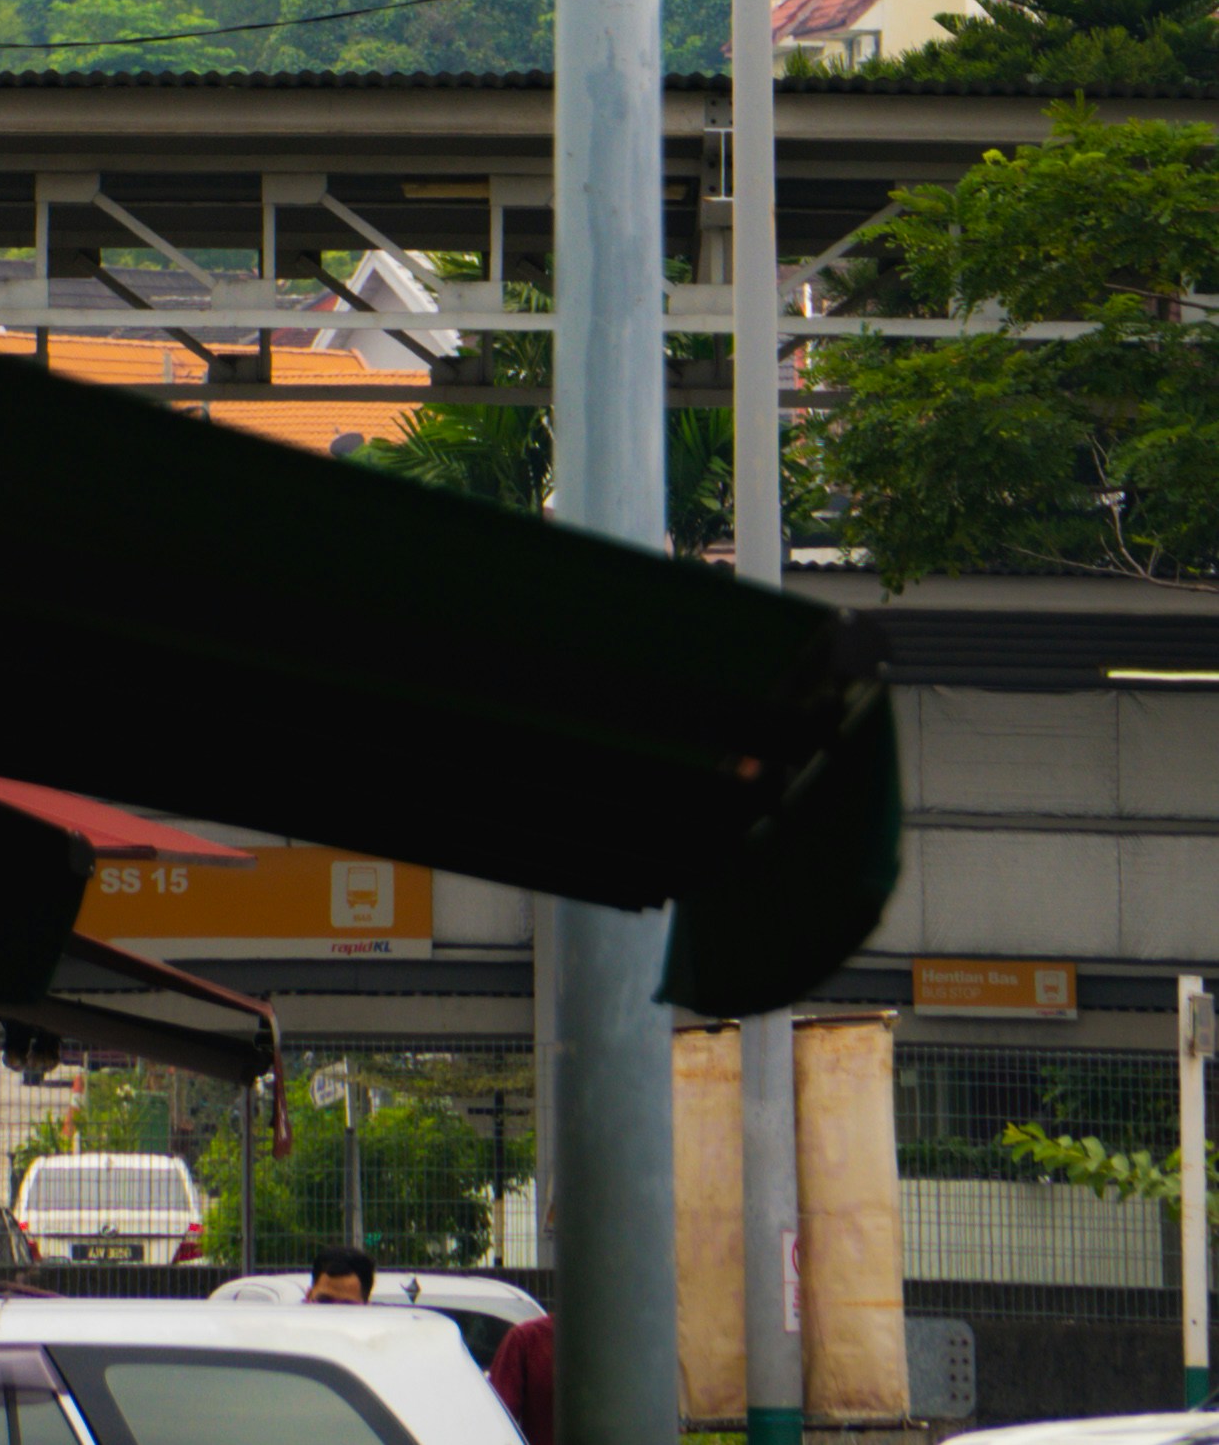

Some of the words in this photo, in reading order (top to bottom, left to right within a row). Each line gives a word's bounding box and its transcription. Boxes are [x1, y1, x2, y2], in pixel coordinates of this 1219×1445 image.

[99, 867, 142, 894] SS
[150, 867, 189, 894] 15
[331, 940, 394, 956] rapidKL
[921, 968, 984, 984] Hentian
[988, 971, 1019, 986] Bas
